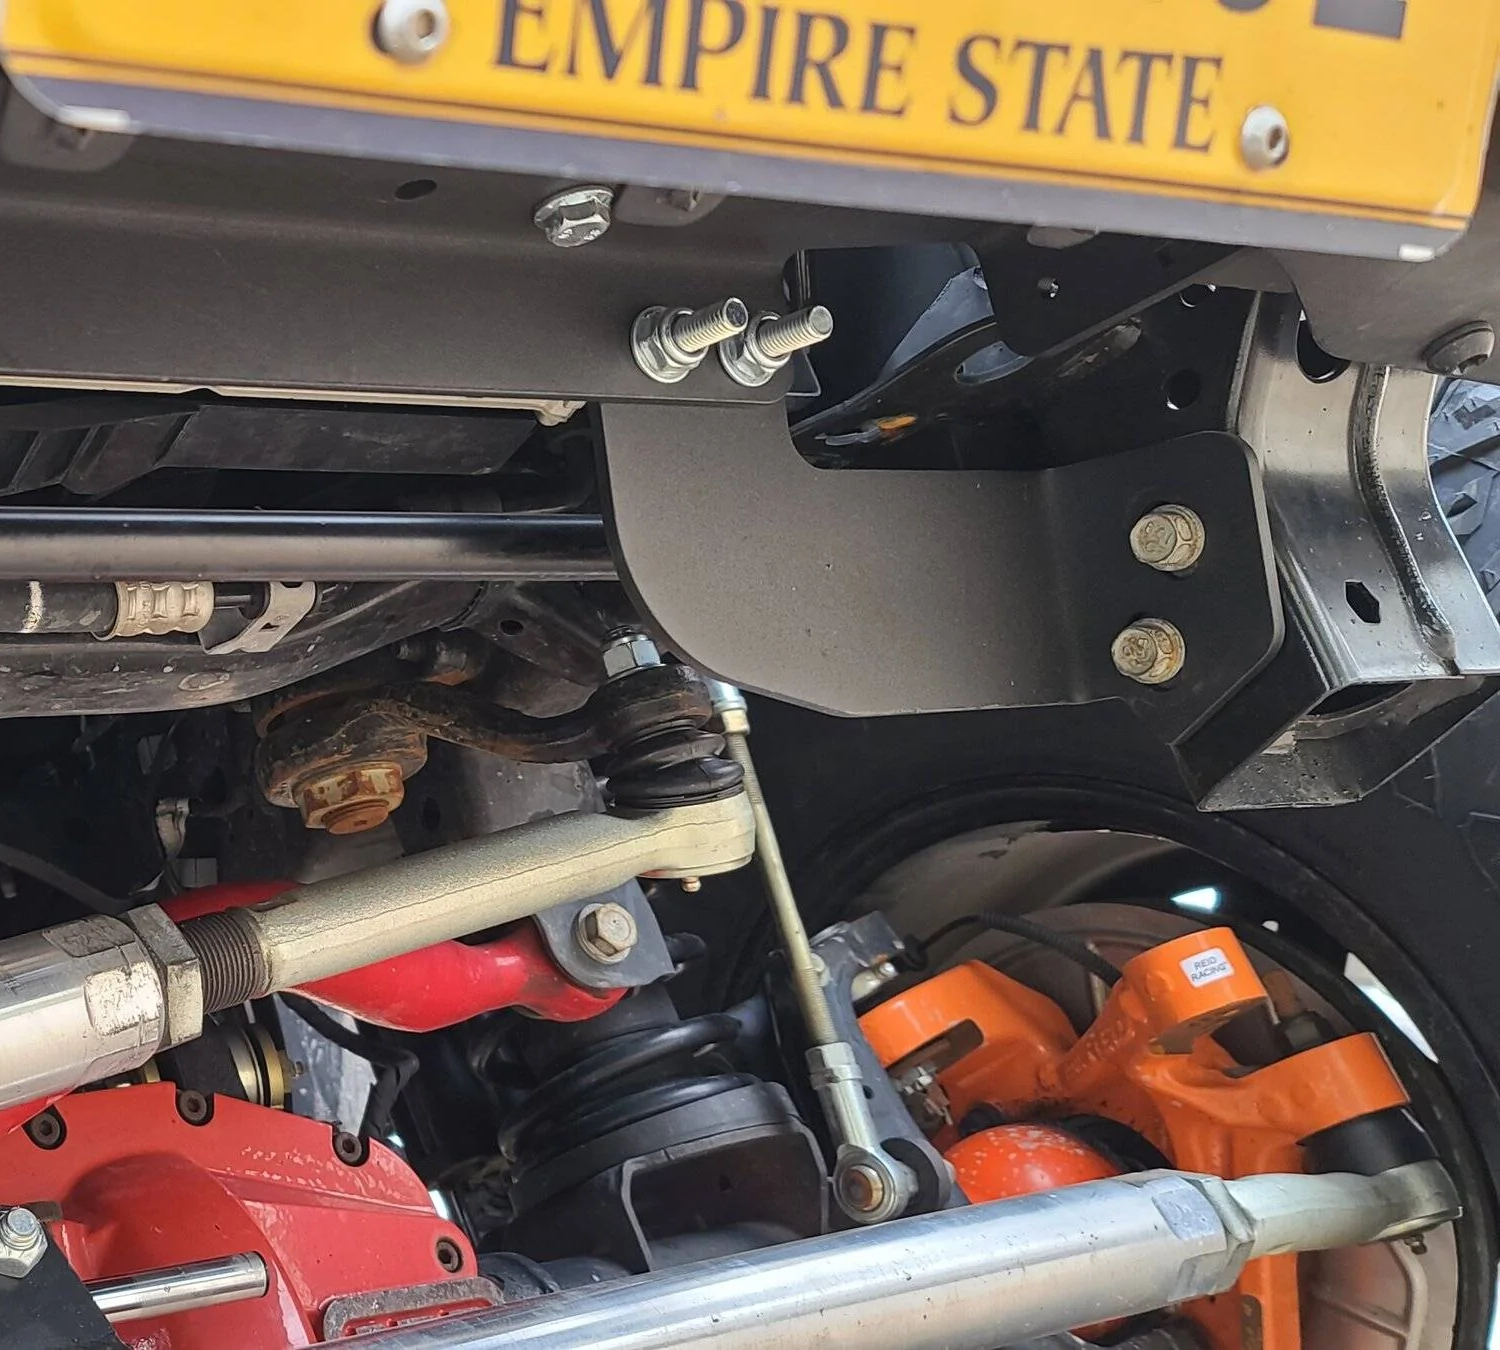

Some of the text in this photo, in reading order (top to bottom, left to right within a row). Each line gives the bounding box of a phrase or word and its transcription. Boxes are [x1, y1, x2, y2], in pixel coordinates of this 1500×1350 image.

[491, 0, 1223, 154] EMPIRE STATE
[1191, 962, 1227, 981] RACING
